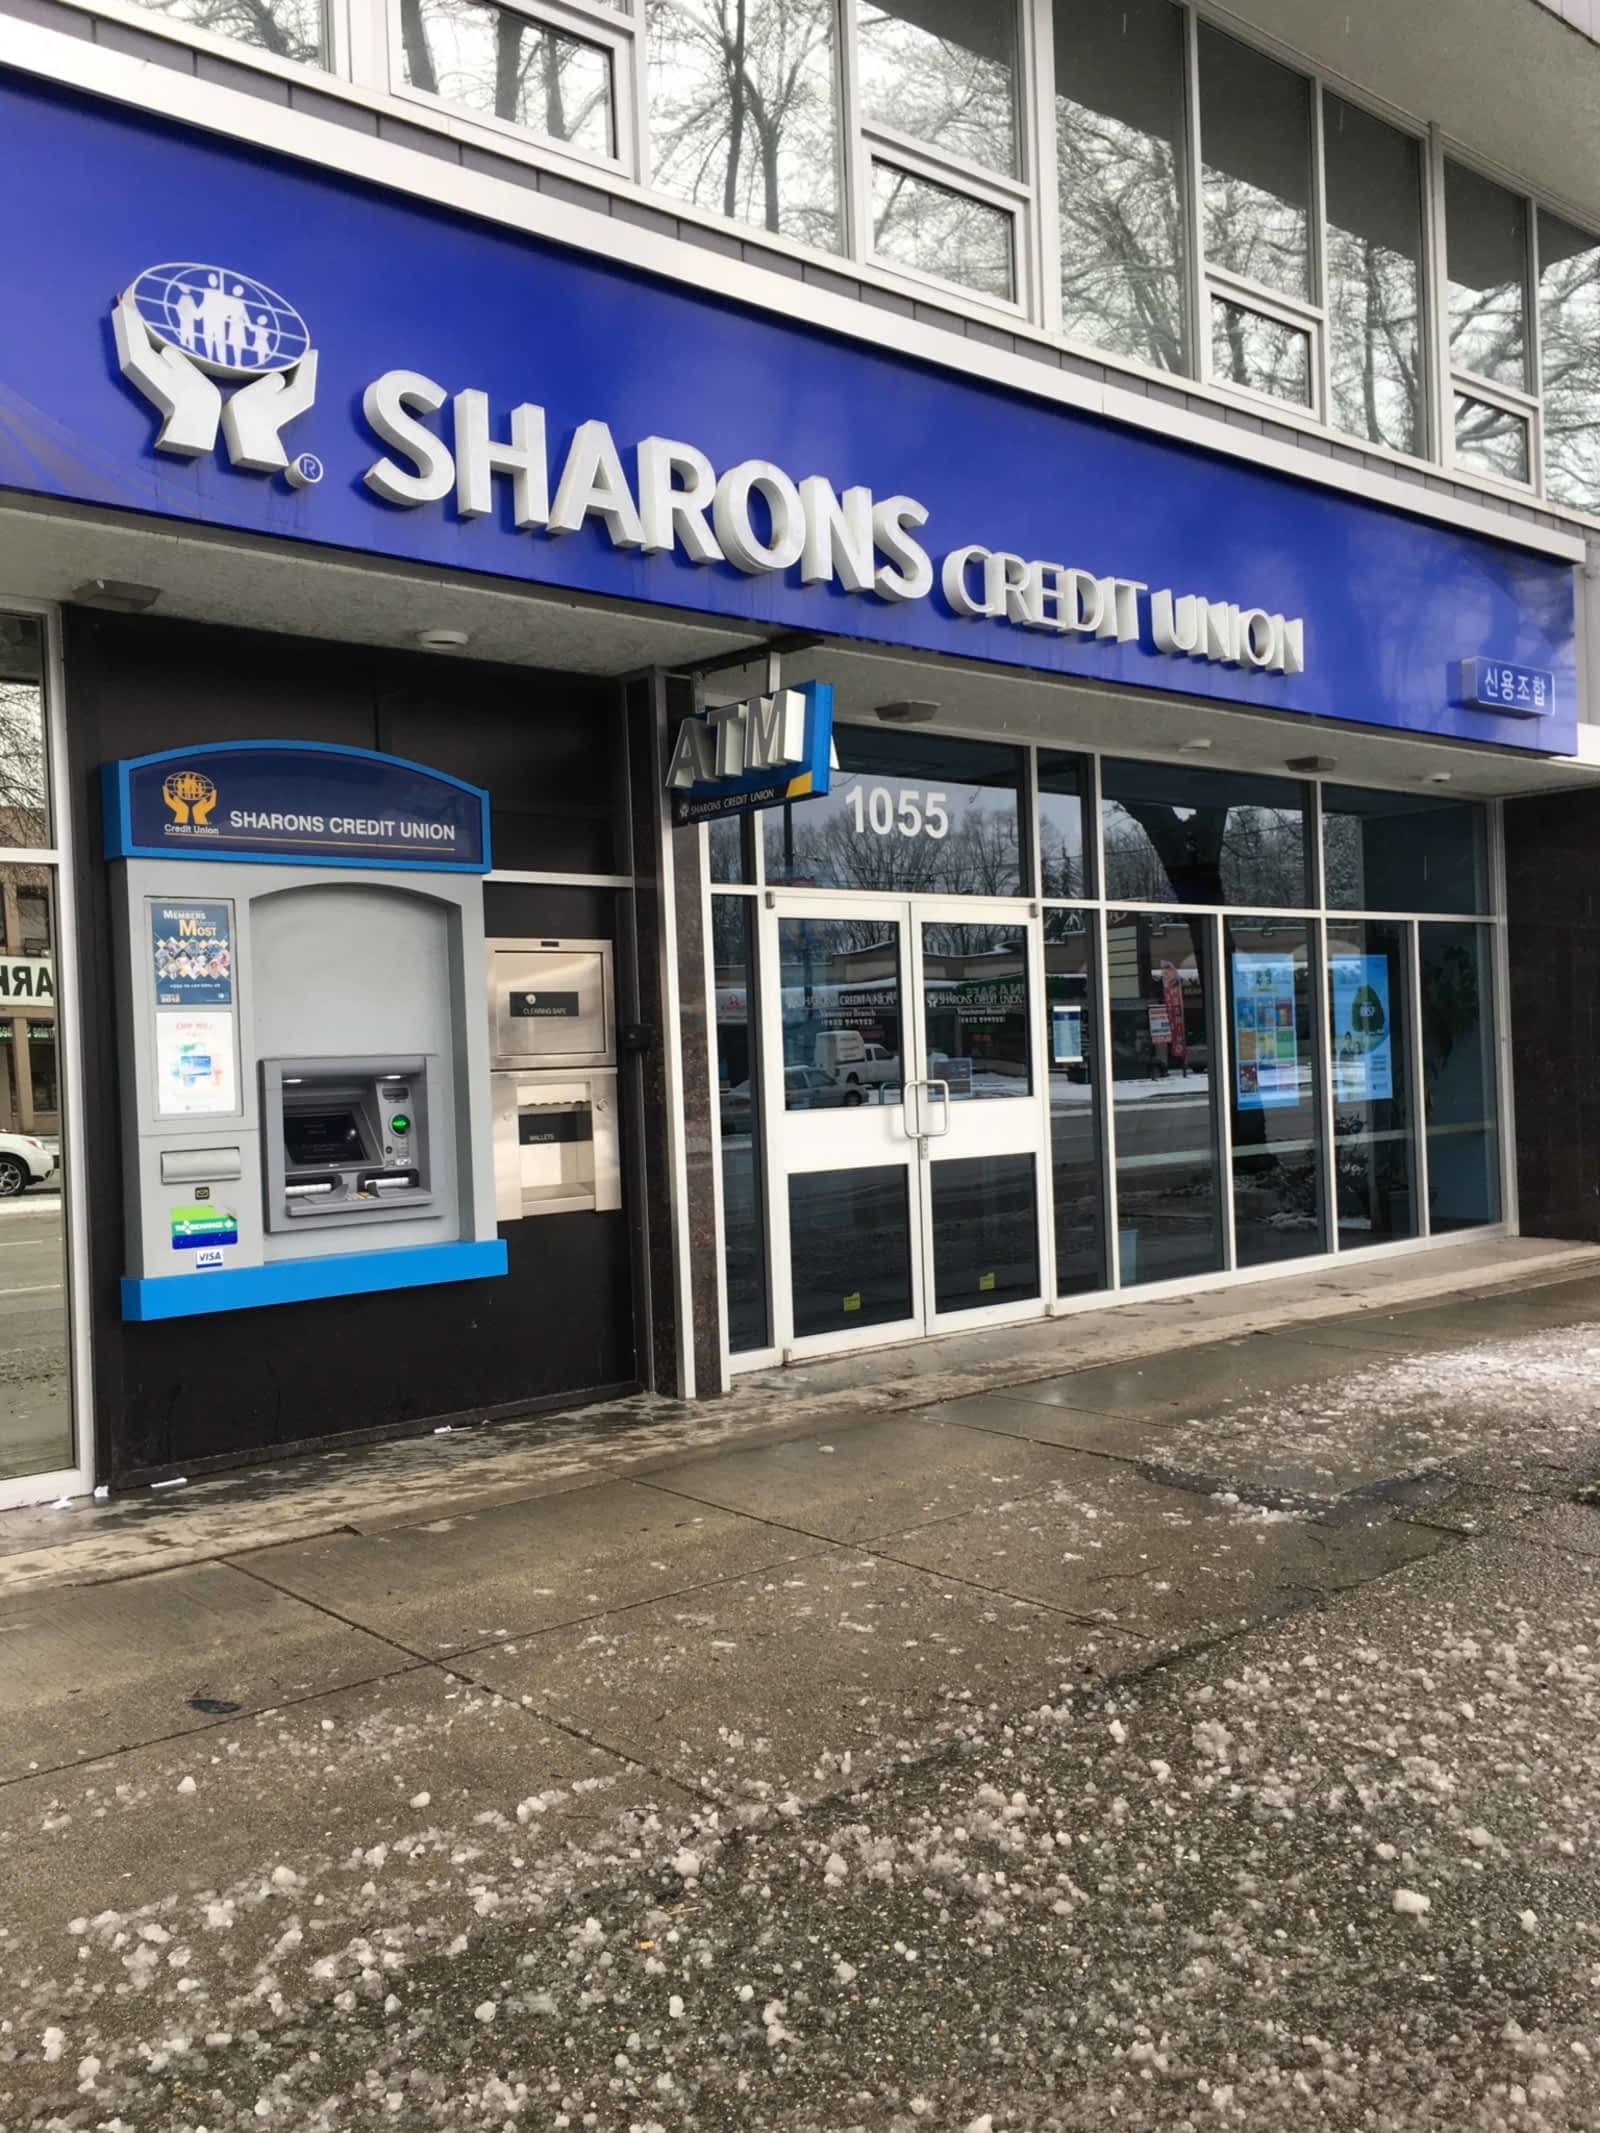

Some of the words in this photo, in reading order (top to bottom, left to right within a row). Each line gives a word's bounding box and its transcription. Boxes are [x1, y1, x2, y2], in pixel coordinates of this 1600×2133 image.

[363, 369, 934, 602] SHARONS
[942, 545, 1147, 642] CREDIT
[1151, 589, 1304, 674] UNION
[1484, 667, 1546, 706] 신용조합
[665, 689, 800, 788] ATM
[723, 795, 748, 809] CREDIT
[750, 789, 775, 802] UNION
[845, 785, 949, 839] 1055
[164, 823, 192, 833] Credit
[193, 825, 219, 835] Union
[230, 810, 324, 833] SHARONS
[329, 817, 395, 837] CREDIT
[400, 821, 456, 840] UNION
[180, 919, 217, 937] MOST
[200, 1251, 222, 1262] VISA
